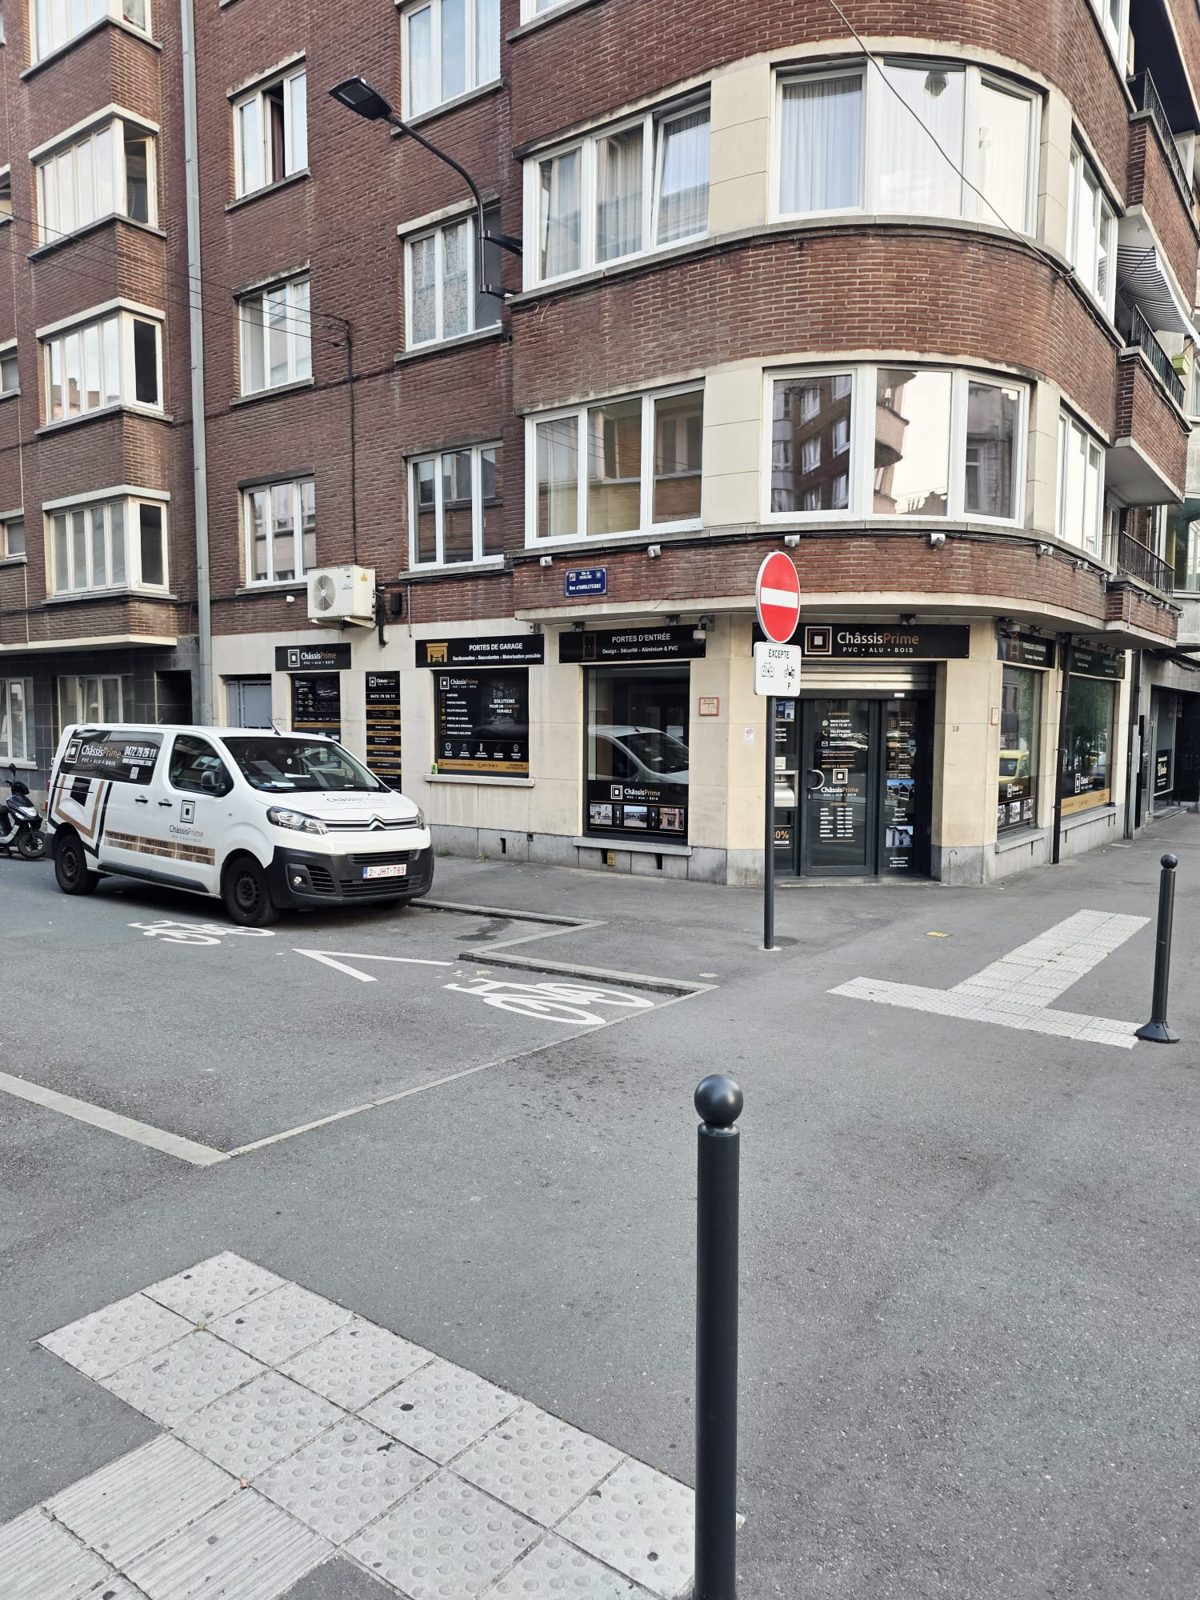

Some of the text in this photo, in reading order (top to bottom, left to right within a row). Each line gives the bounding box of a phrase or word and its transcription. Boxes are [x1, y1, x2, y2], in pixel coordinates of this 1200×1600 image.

[638, 632, 671, 642] D'ENTRÉE
[837, 631, 920, 644] ChâssisPrime
[301, 652, 336, 660] ChâssisPrime
[81, 745, 121, 759] ChâssisPrime
[624, 788, 660, 797] ChâssisPrime
[169, 824, 204, 838] ChâssisPrime
